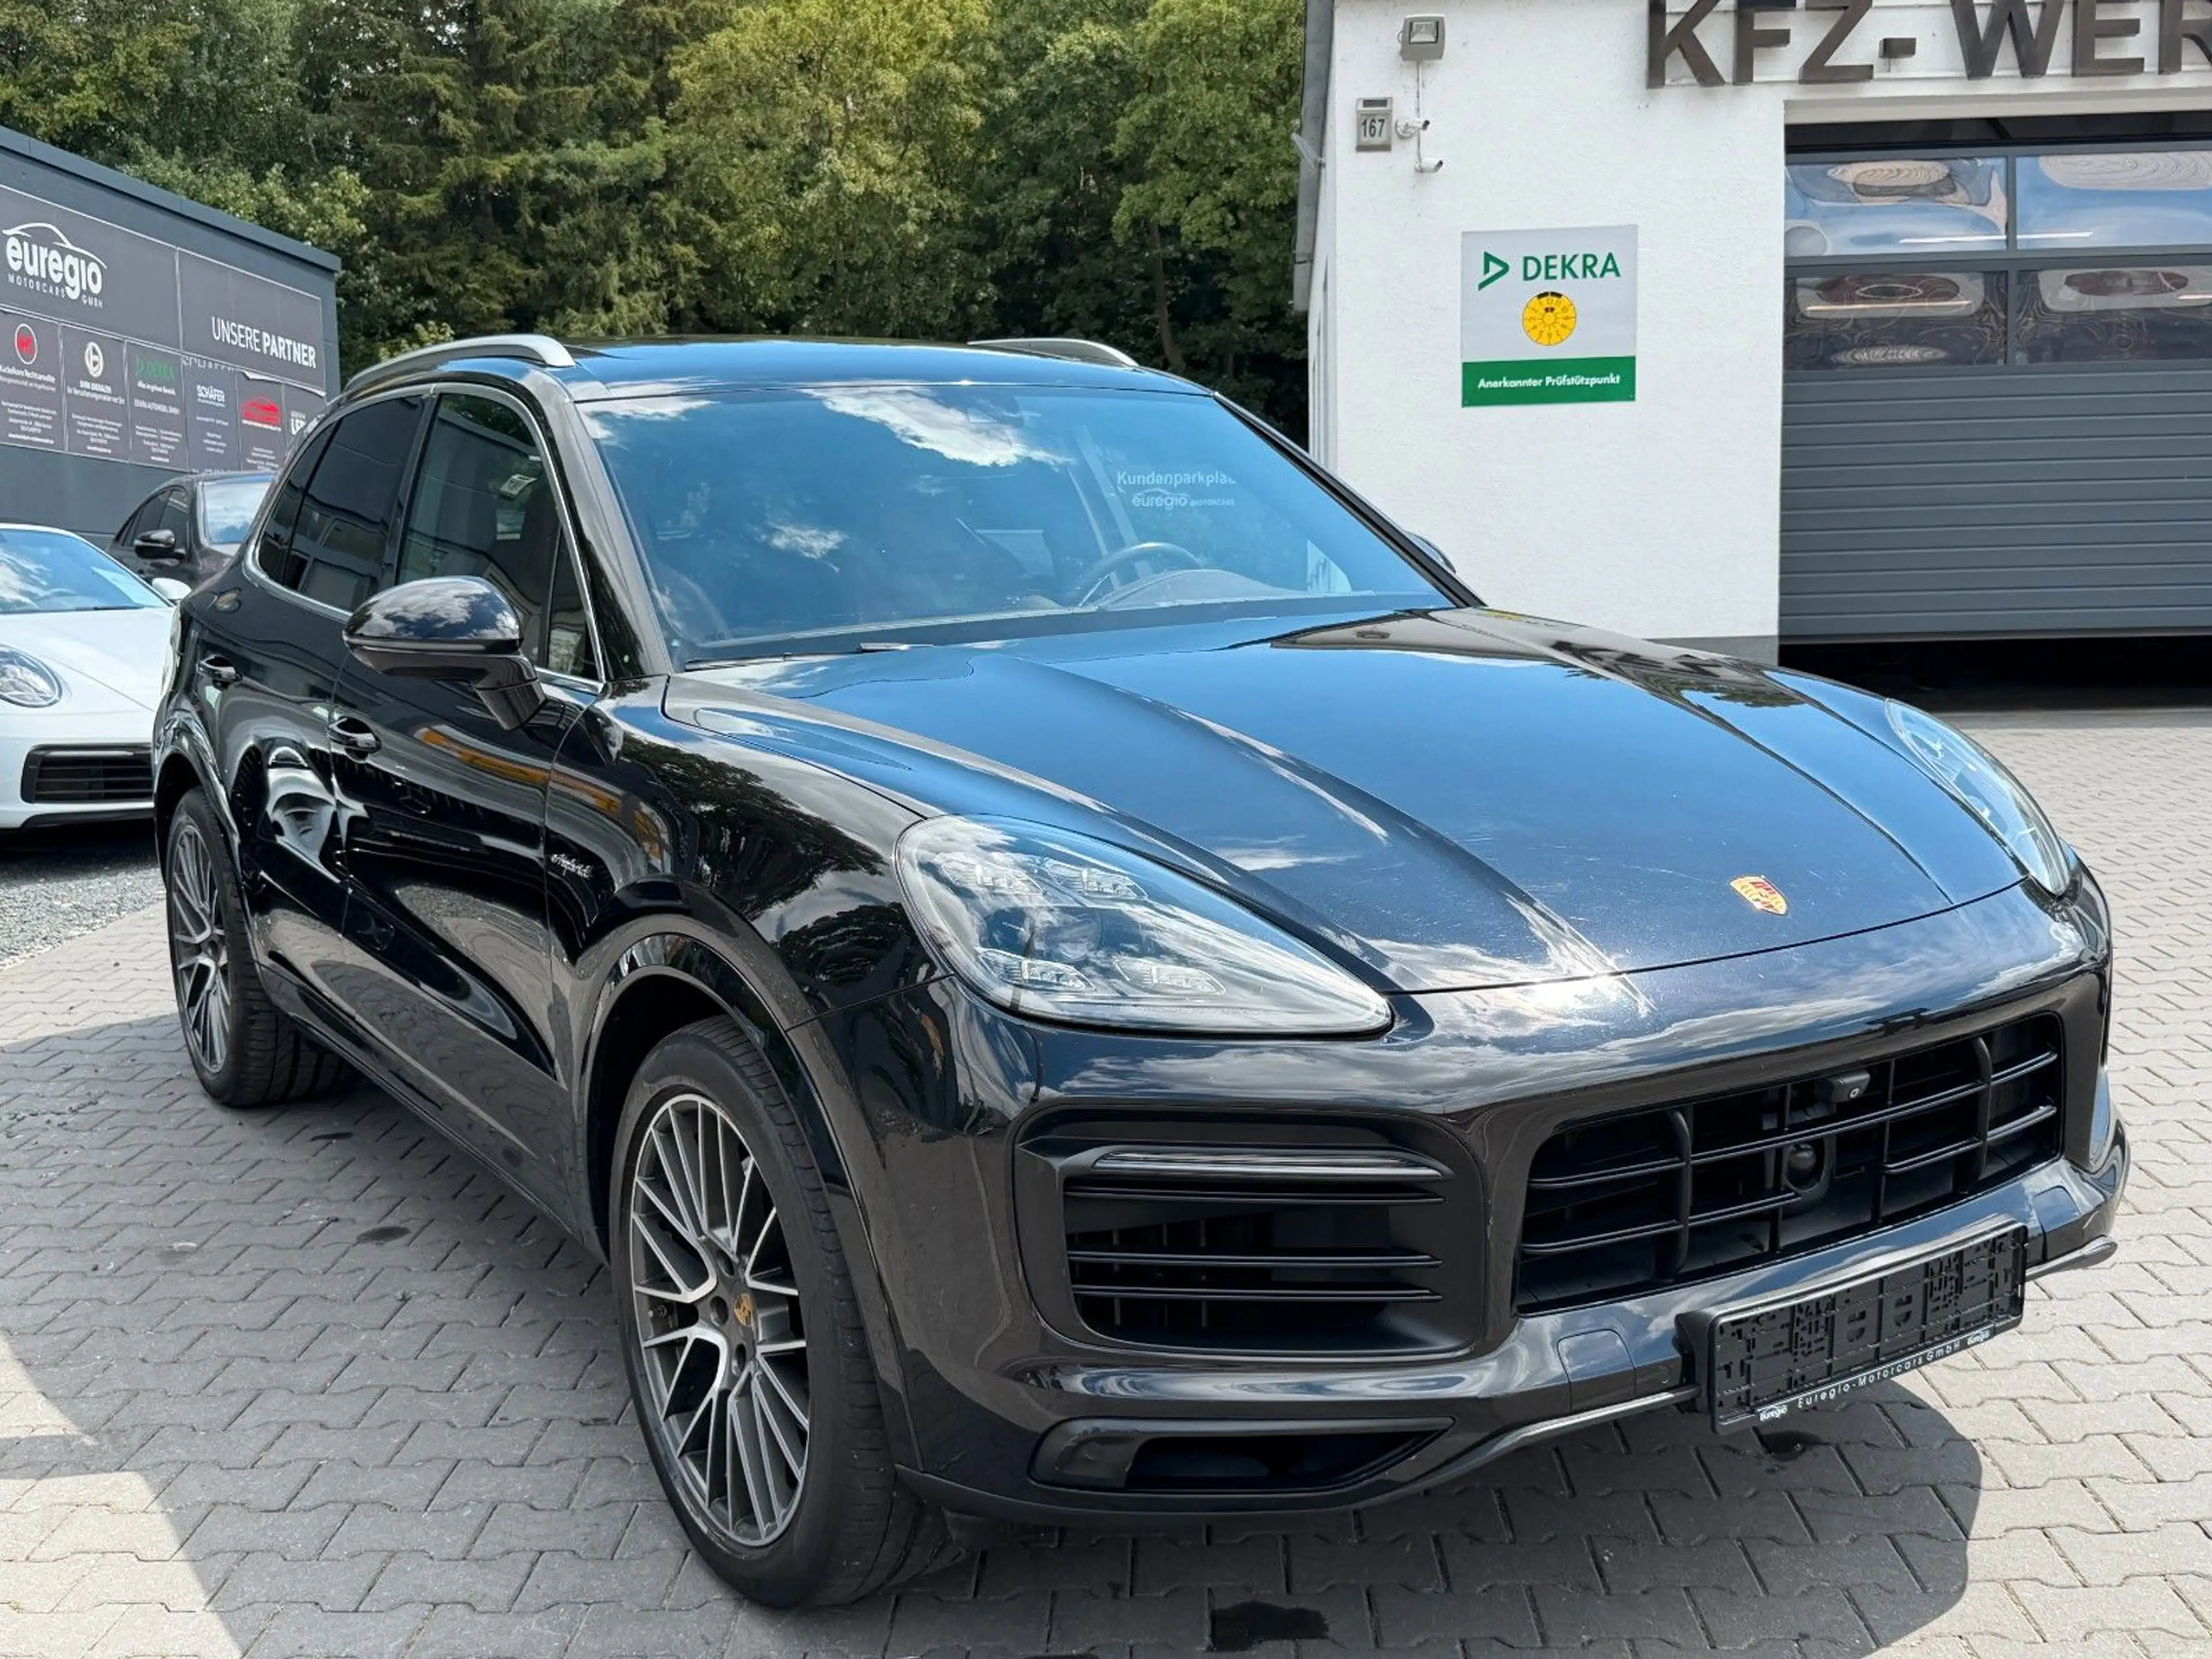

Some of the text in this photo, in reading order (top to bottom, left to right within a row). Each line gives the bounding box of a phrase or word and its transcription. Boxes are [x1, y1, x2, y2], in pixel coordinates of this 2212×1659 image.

[1362, 118, 1385, 138] 167
[6, 236, 102, 300] euregio
[1522, 252, 1622, 281] DEKRA
[211, 316, 261, 353] UNSERE
[262, 331, 317, 369] PARTNER
[1477, 373, 1621, 389] Anerkannter Prüfstützpunkt
[1117, 471, 1236, 487] Kundenparkpla
[1132, 494, 1188, 509] euregio
[1926, 1340, 1961, 1362] GmbH
